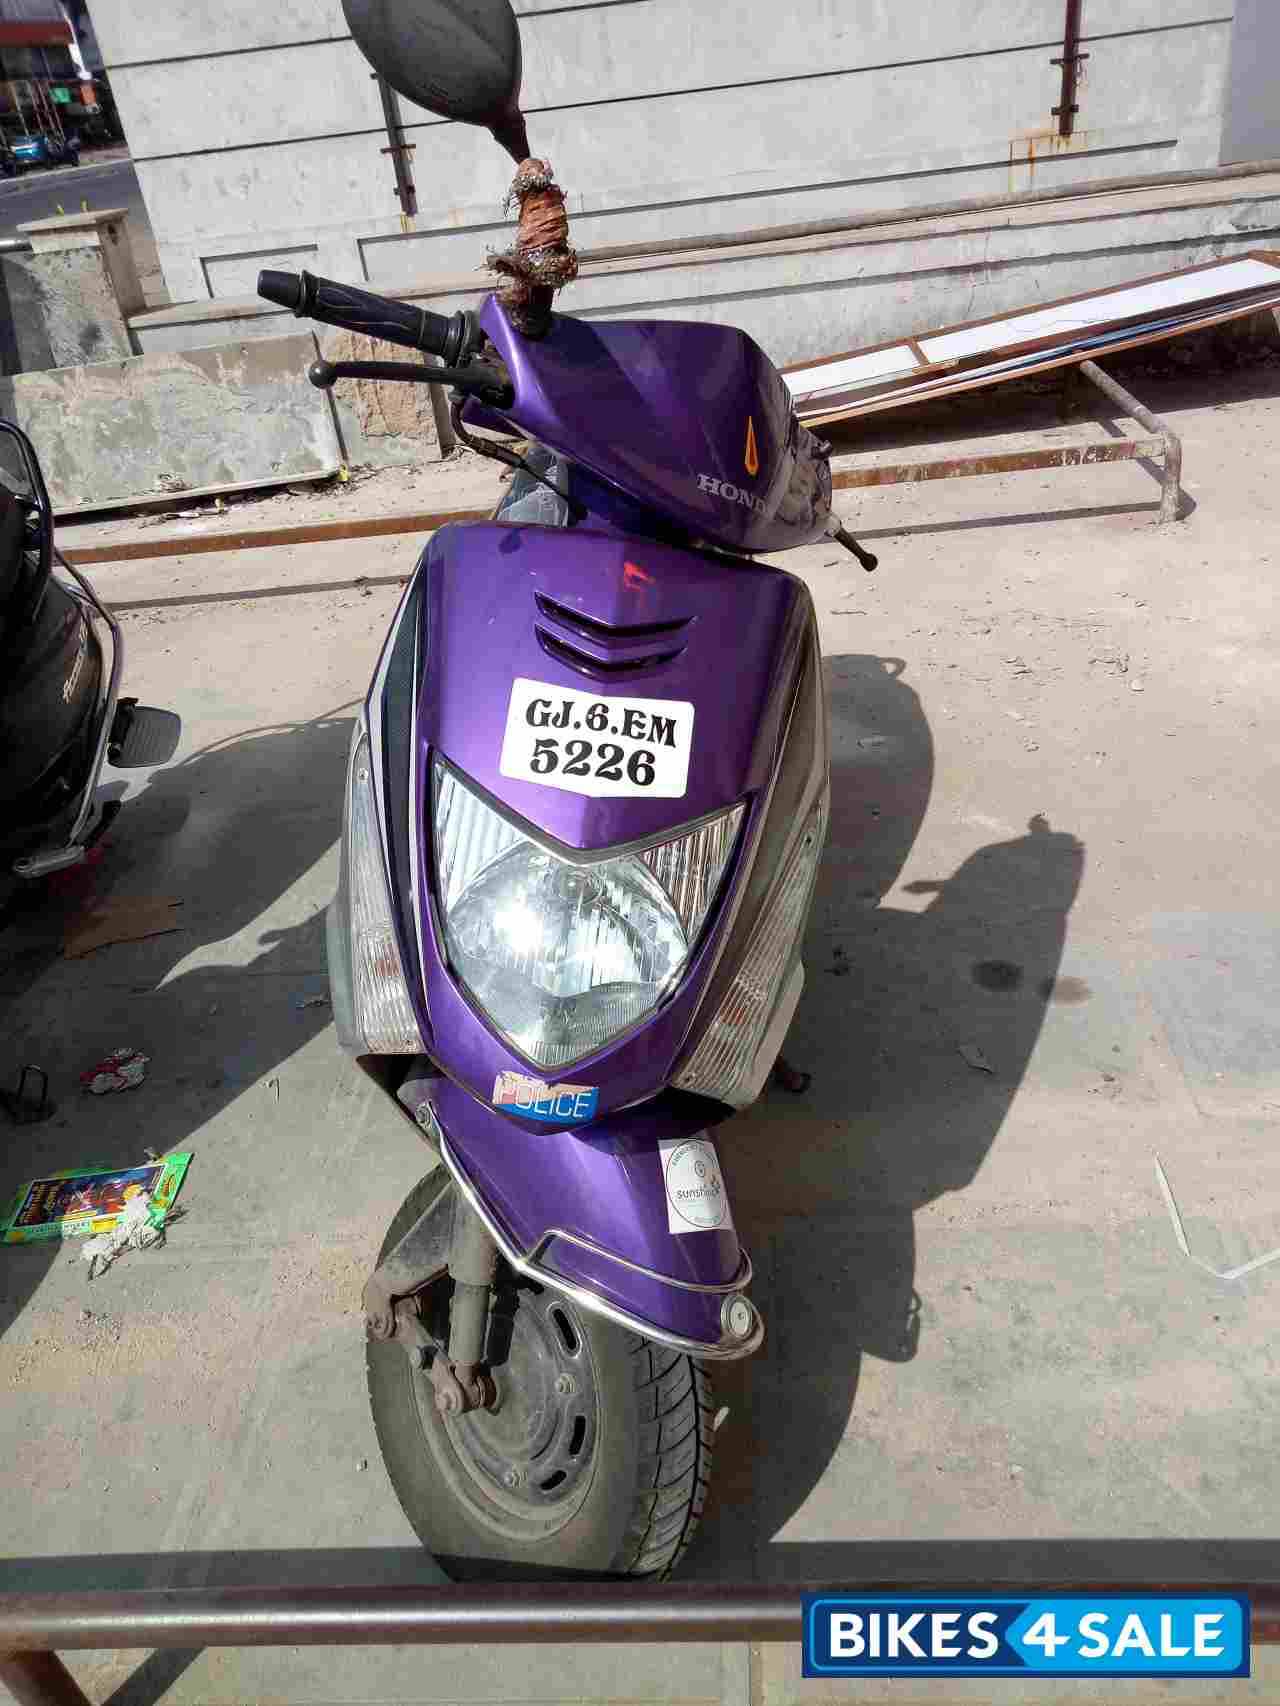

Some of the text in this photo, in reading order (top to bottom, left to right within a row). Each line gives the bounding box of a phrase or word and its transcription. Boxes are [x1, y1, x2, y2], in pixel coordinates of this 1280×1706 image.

[697, 473, 768, 513] HOND
[525, 698, 677, 748] GJ.6.EM
[529, 738, 656, 786] 5226
[500, 1084, 592, 1118] POLICE
